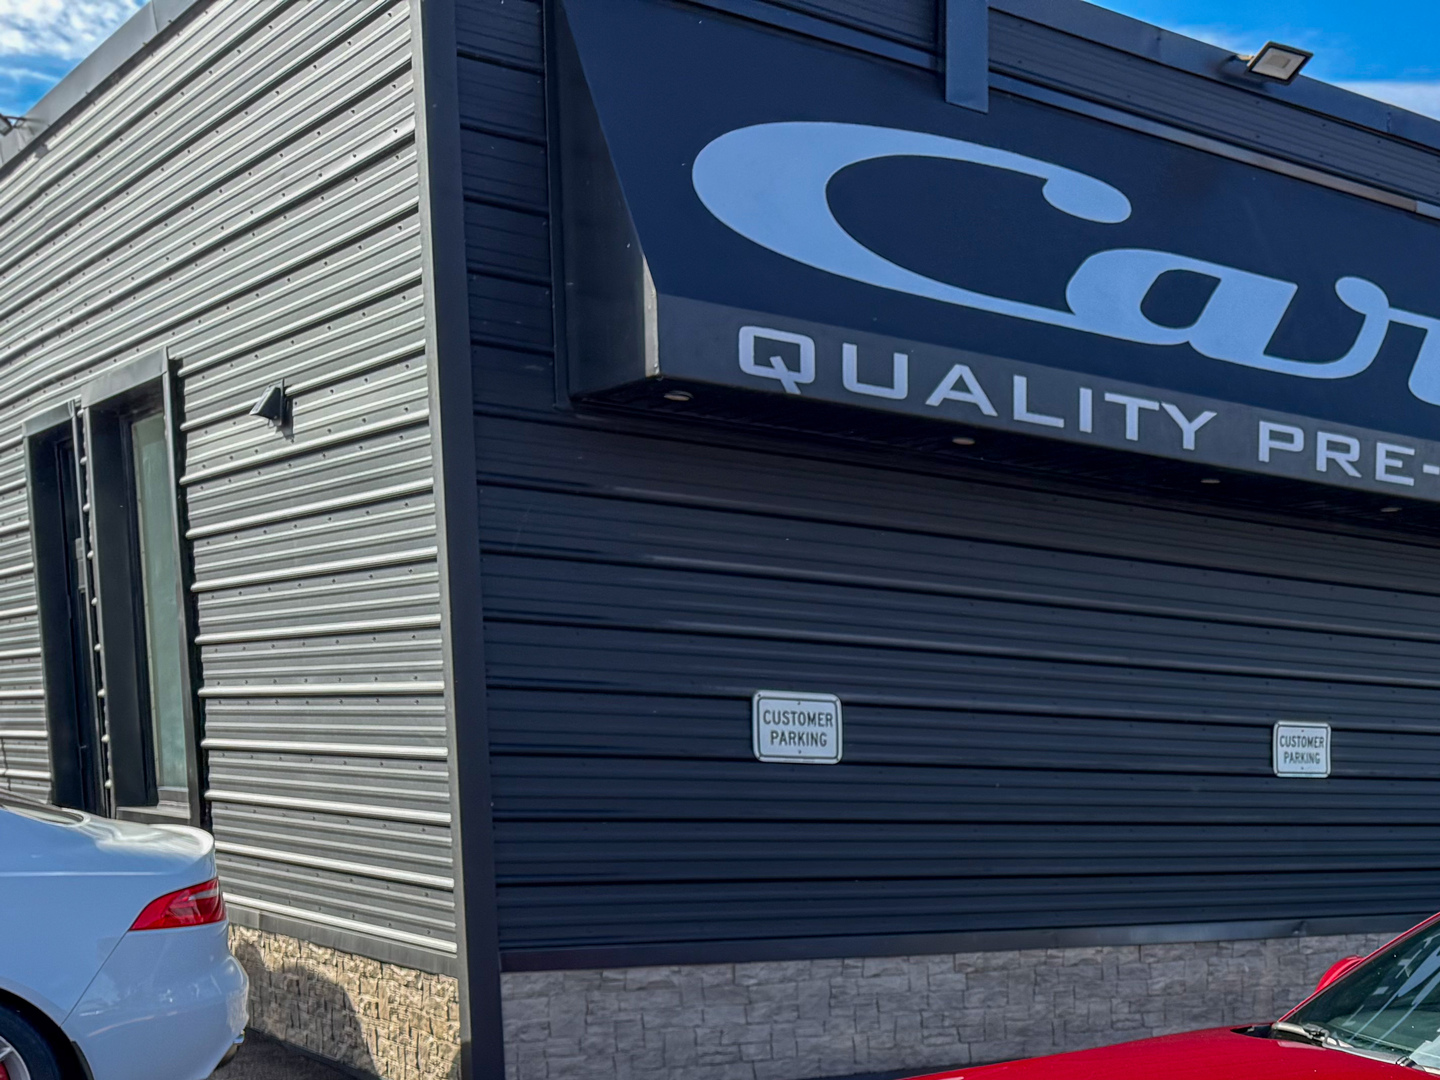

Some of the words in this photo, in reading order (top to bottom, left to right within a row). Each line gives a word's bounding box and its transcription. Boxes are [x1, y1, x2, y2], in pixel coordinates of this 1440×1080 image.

[738, 325, 1217, 451] QUALITY
[763, 710, 834, 727] CUSTOMER
[770, 730, 828, 747] PARKING
[1280, 735, 1324, 748] CUSTOMER
[1284, 751, 1321, 764] PARKING
